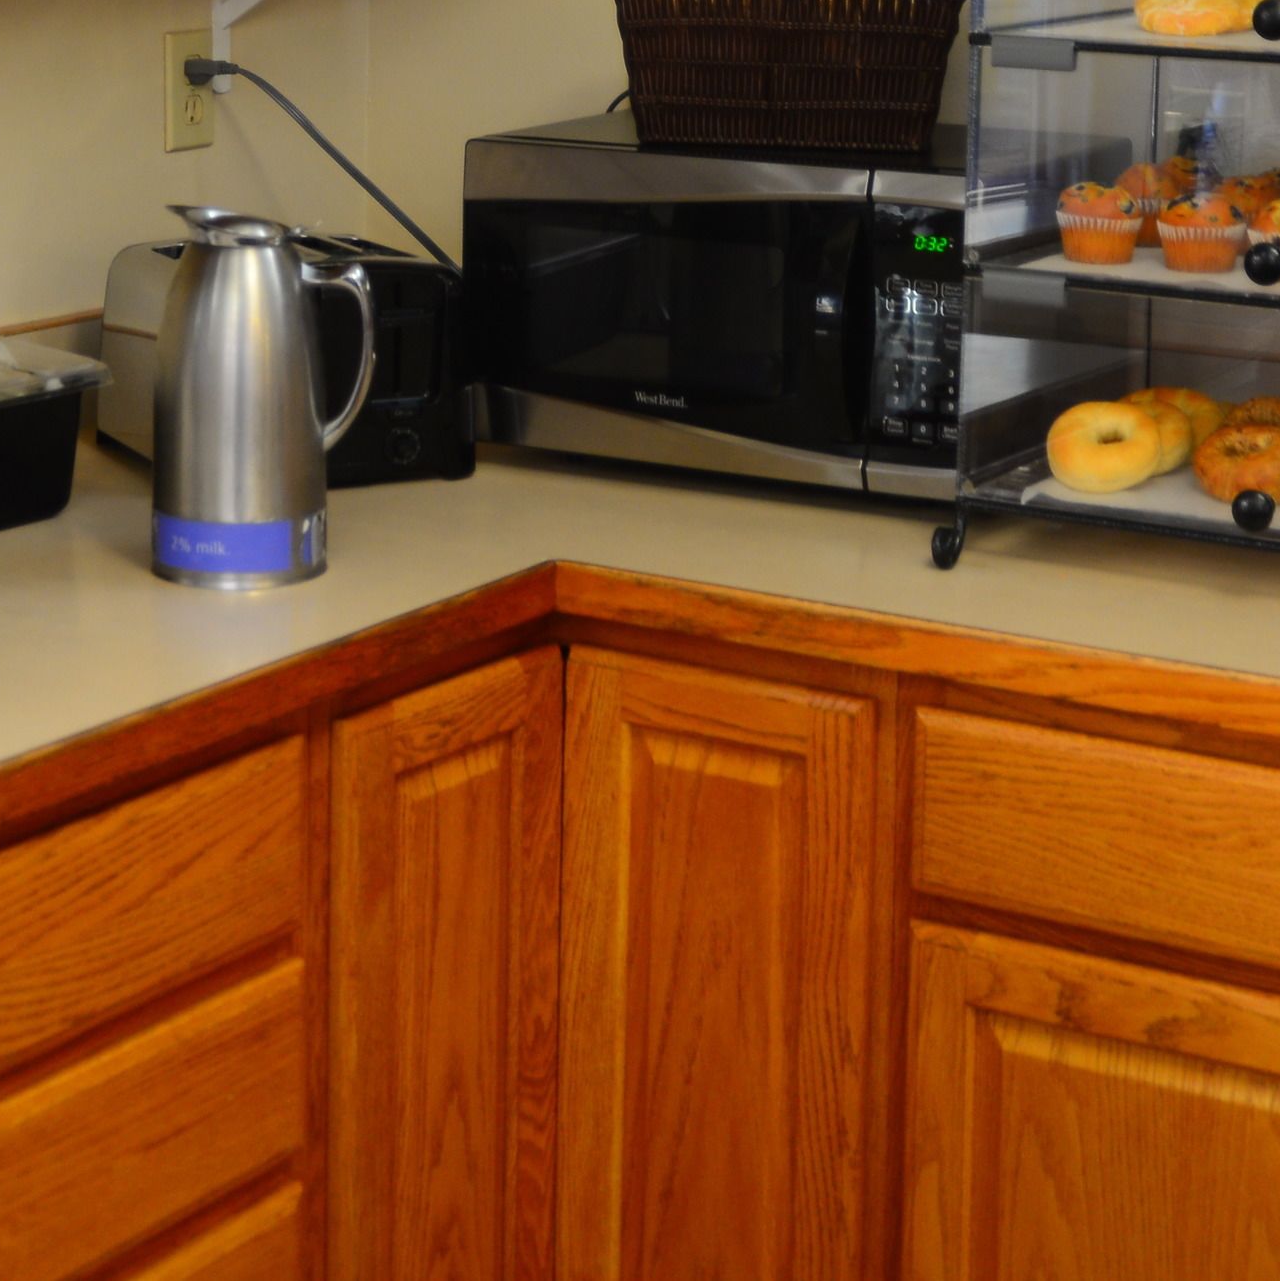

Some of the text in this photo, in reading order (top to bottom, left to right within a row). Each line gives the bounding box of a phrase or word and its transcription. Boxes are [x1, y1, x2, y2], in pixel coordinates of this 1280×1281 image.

[634, 390, 686, 407] West Bend
[171, 535, 191, 553] 2%
